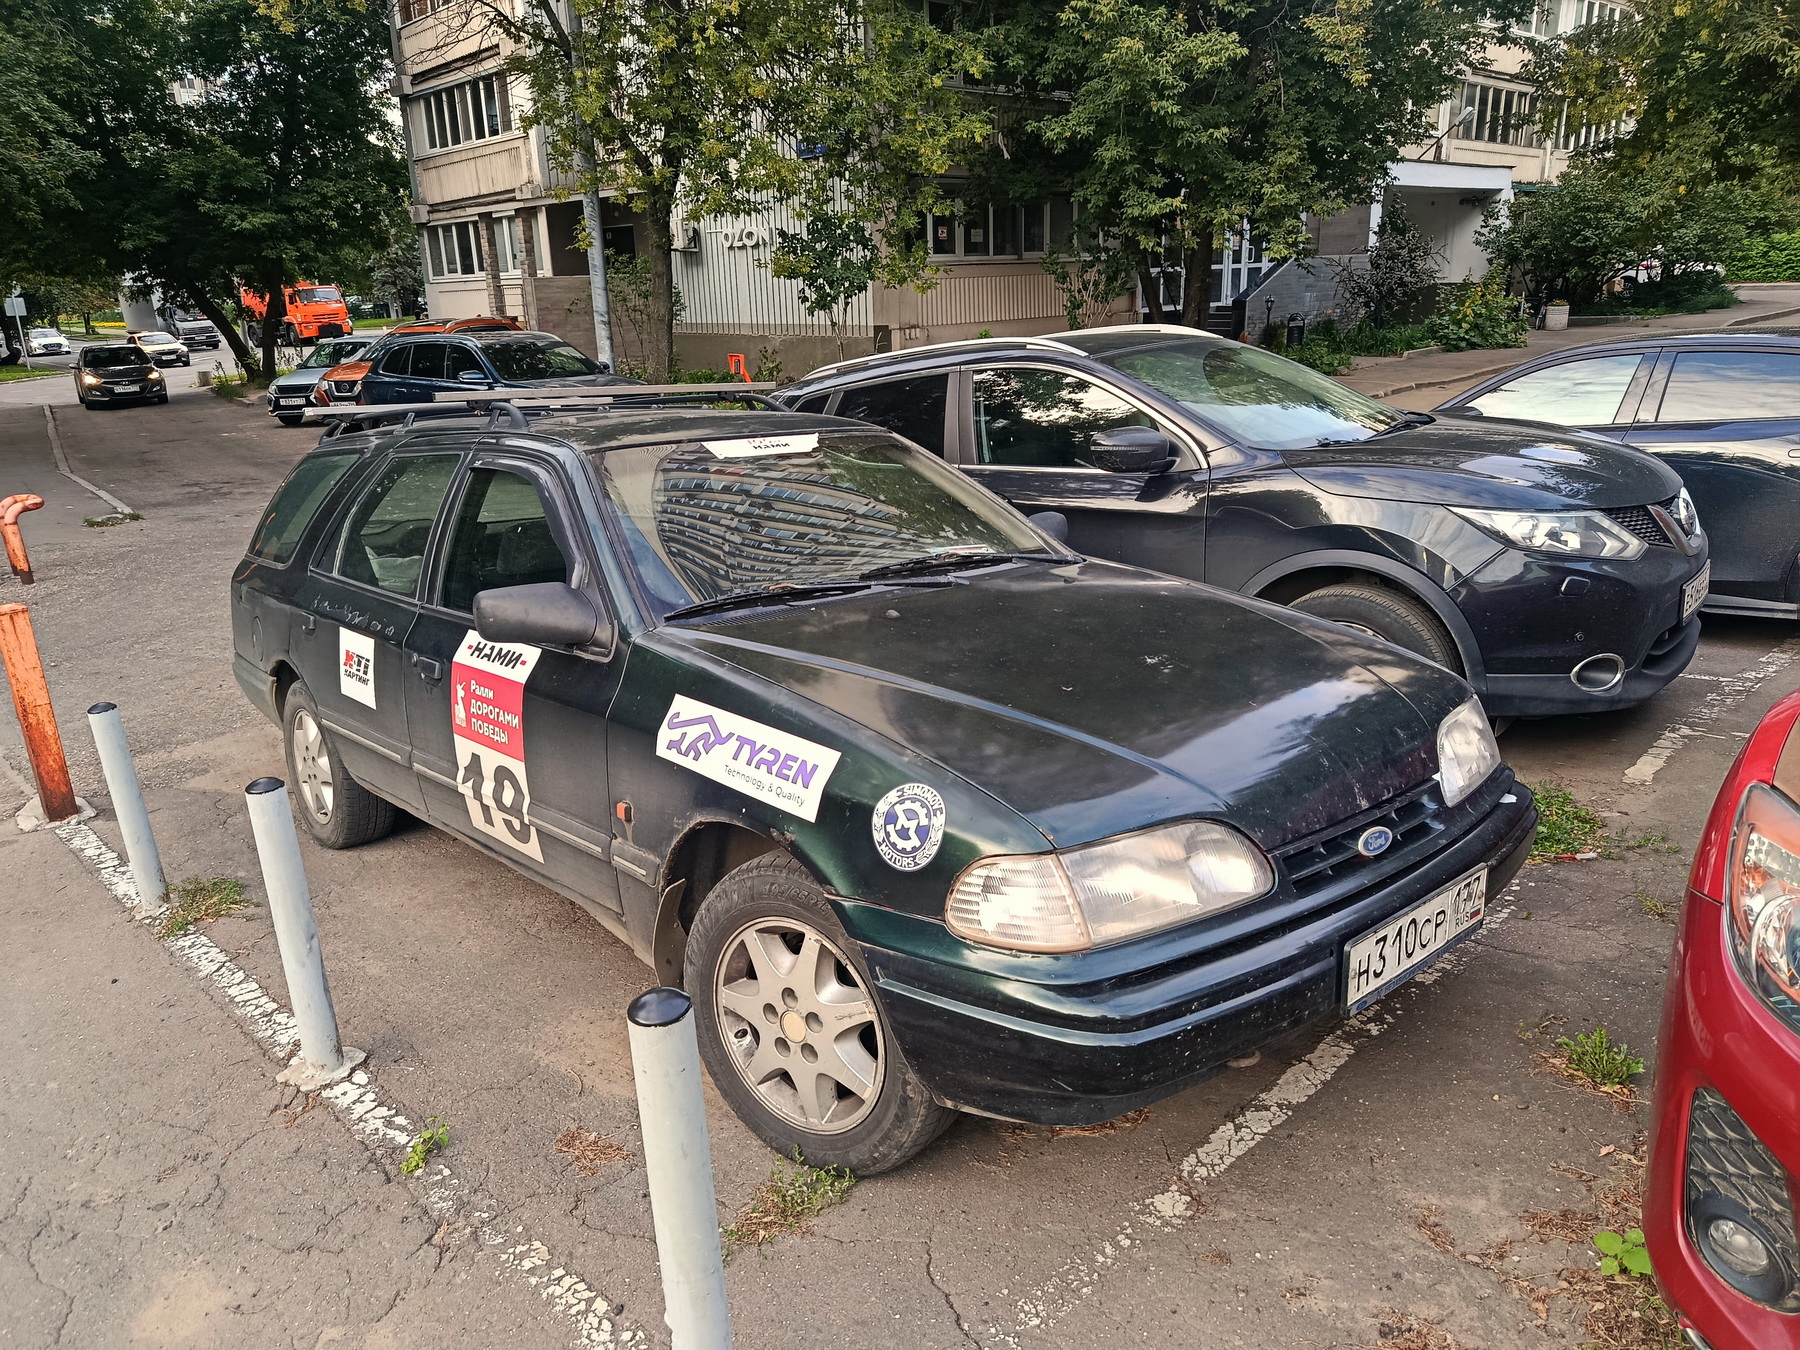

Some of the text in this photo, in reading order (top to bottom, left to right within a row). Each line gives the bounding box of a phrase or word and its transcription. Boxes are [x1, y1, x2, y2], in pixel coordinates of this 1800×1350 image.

[470, 641, 523, 669] НАМИ
[344, 668, 370, 686] КАРТИНГ
[470, 680, 494, 700] Ралли
[470, 699, 519, 729] ДОРОГАМИ
[471, 718, 509, 744] ПОБЕДЫ
[732, 734, 819, 790] TYREN
[462, 752, 532, 845] 19
[724, 764, 806, 808] Technology & Quality
[903, 784, 943, 811] SIMONOV
[879, 841, 916, 869] MOTORS
[1367, 832, 1386, 851] Ford
[1355, 908, 1447, 993] Н310СР
[1452, 875, 1481, 917] 177
[1454, 913, 1470, 930] RUS
